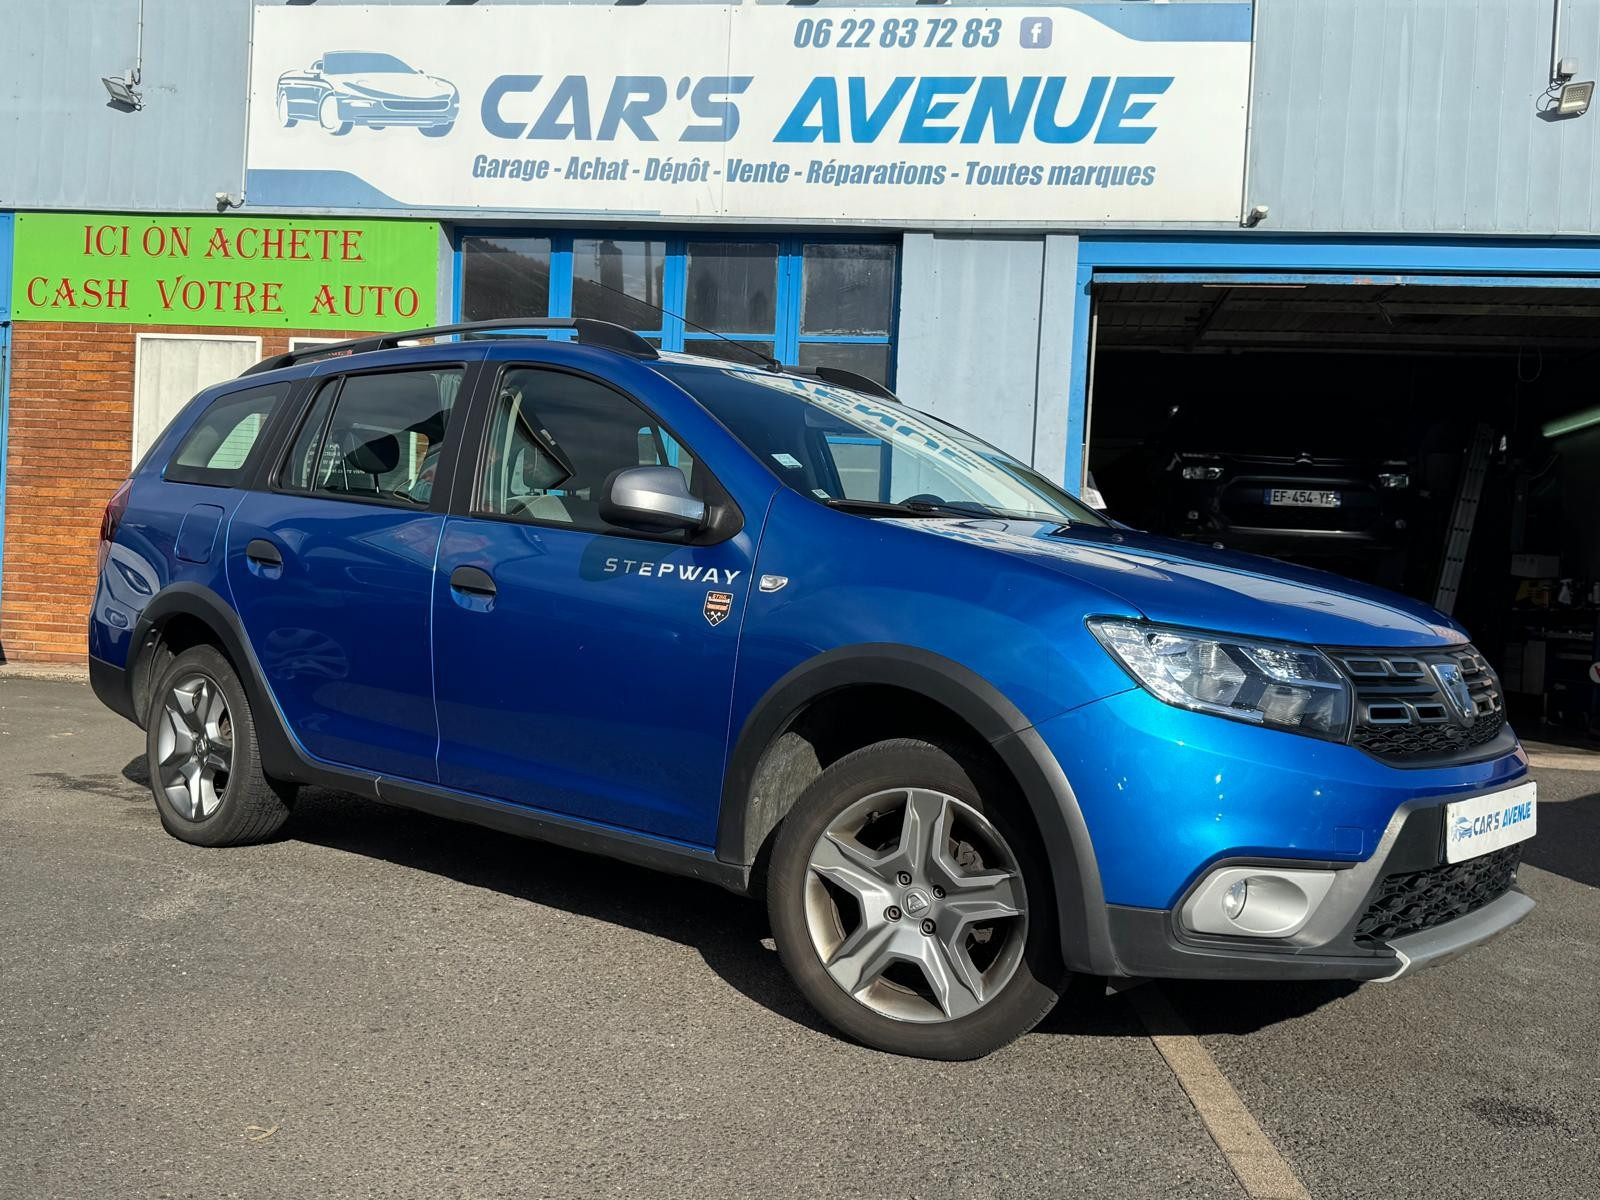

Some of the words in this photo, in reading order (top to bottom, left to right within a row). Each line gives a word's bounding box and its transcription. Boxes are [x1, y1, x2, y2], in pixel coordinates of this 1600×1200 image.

[794, 18, 833, 48] 06
[836, 18, 875, 48] 22
[879, 18, 919, 48] 83
[923, 18, 958, 48] 72
[962, 18, 1002, 48] 83
[480, 74, 755, 142] CAR'S
[772, 76, 1176, 144] AVENUE
[472, 155, 549, 181] Garage
[564, 156, 629, 181] Achat
[644, 156, 710, 184] Dépôt
[726, 158, 790, 183] Vente
[806, 159, 946, 186] Réparations
[965, 161, 1044, 186] Toutes
[1047, 165, 1156, 188] marques
[84, 225, 130, 257] ICI
[142, 226, 191, 258] ON
[204, 227, 364, 262] ACHETE
[27, 277, 129, 309] CASH
[156, 275, 284, 314] VOTRE
[310, 284, 419, 318] AUTO
[604, 557, 741, 585] STEPWAY
[1502, 801, 1532, 827] AVENUE
